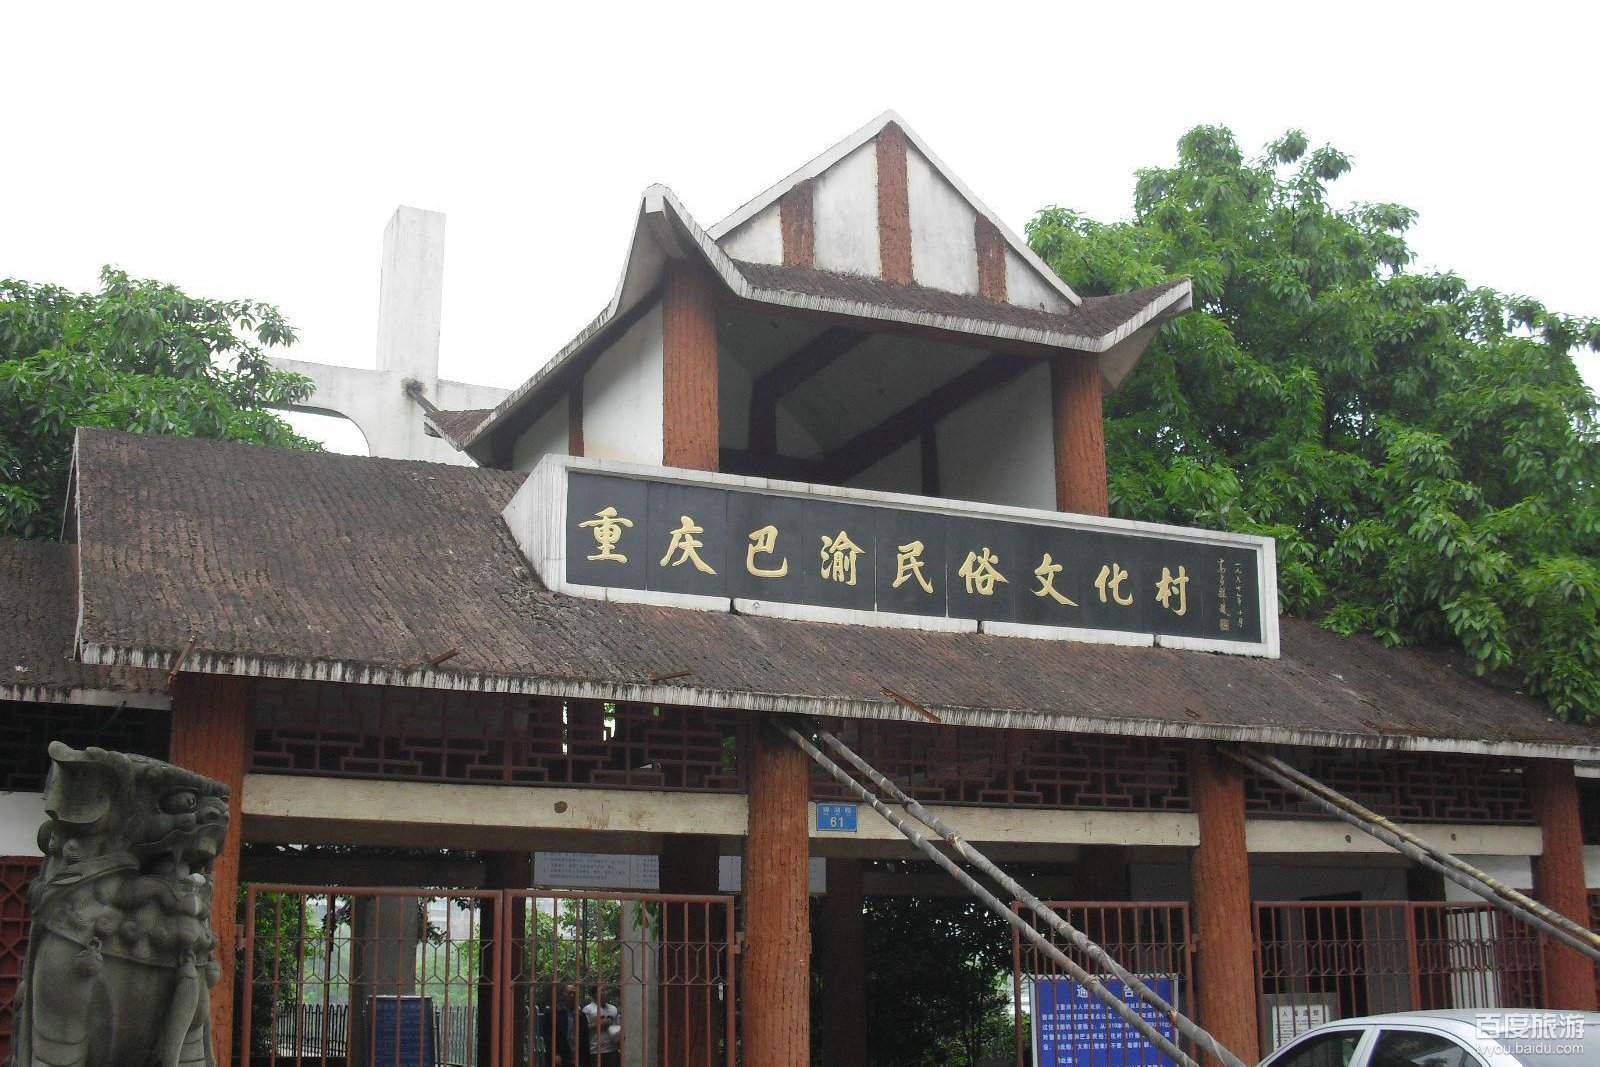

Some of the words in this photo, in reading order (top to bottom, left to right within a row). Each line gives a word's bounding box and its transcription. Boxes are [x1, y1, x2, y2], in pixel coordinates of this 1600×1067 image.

[578, 506, 1190, 616] 重庆巴渝民俗文化村
[831, 816, 843, 828] 61
